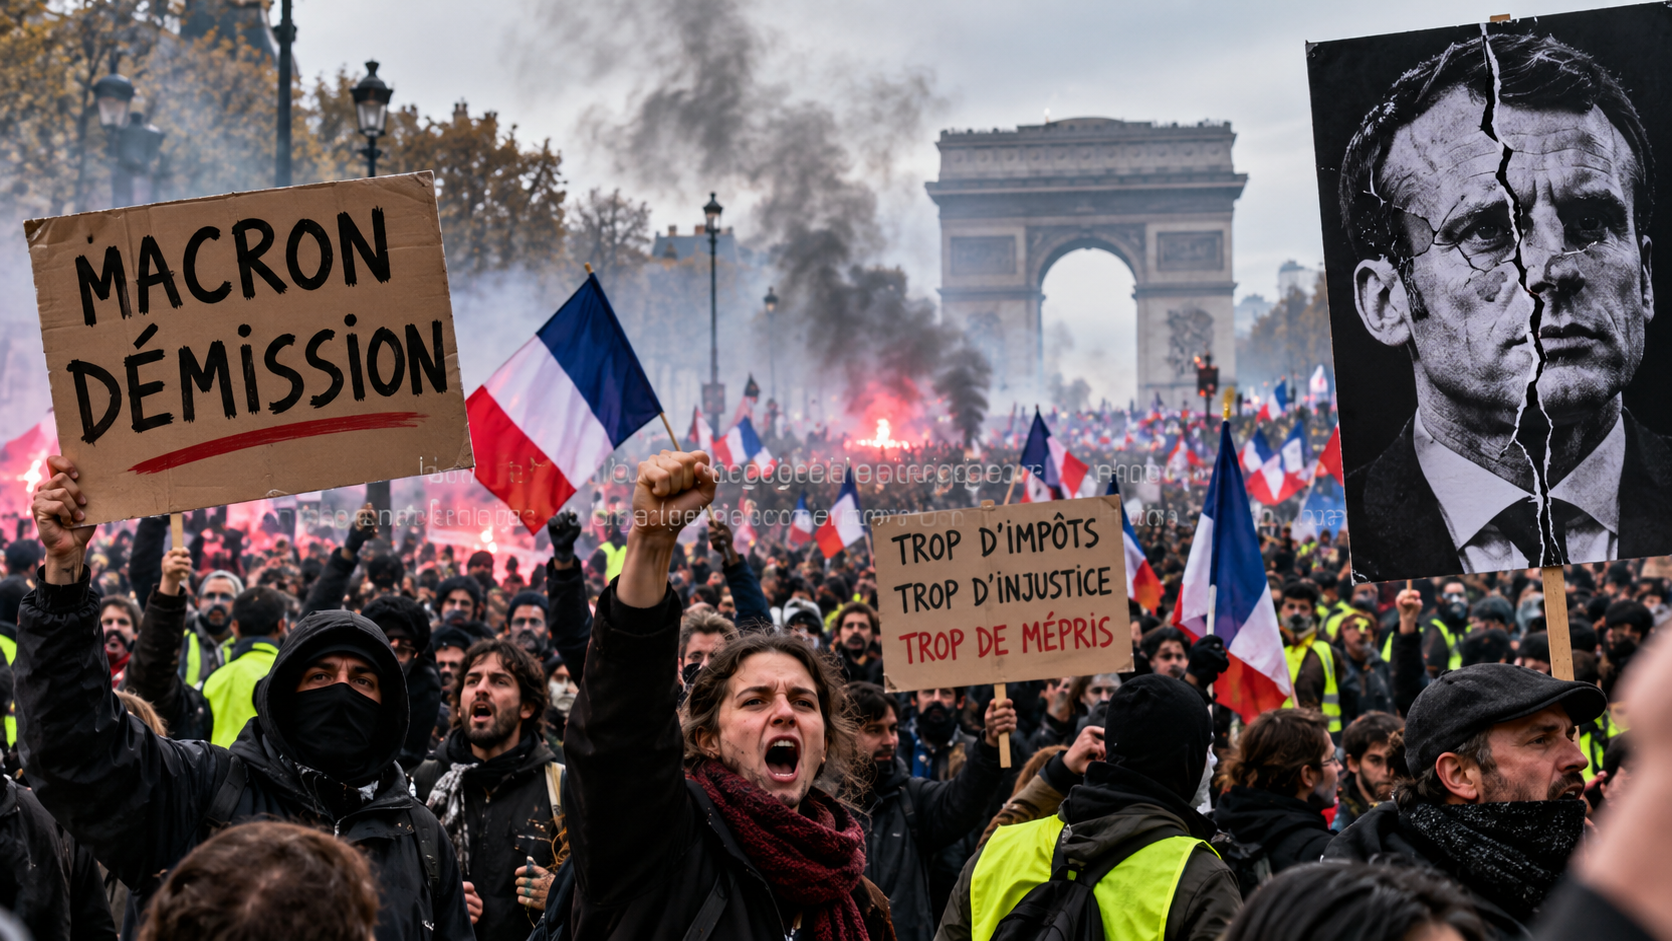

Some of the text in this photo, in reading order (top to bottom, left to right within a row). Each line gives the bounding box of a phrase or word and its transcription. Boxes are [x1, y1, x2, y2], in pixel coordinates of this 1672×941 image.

[75, 205, 391, 327] MACRON
[66, 313, 448, 446] DÉMISSION
[891, 529, 961, 565] TROP
[979, 512, 1099, 558] D'IMPÔTS
[893, 564, 1112, 614] TROP D'INJUSTICE
[898, 611, 1113, 664] TROP DE MÉPRIS
